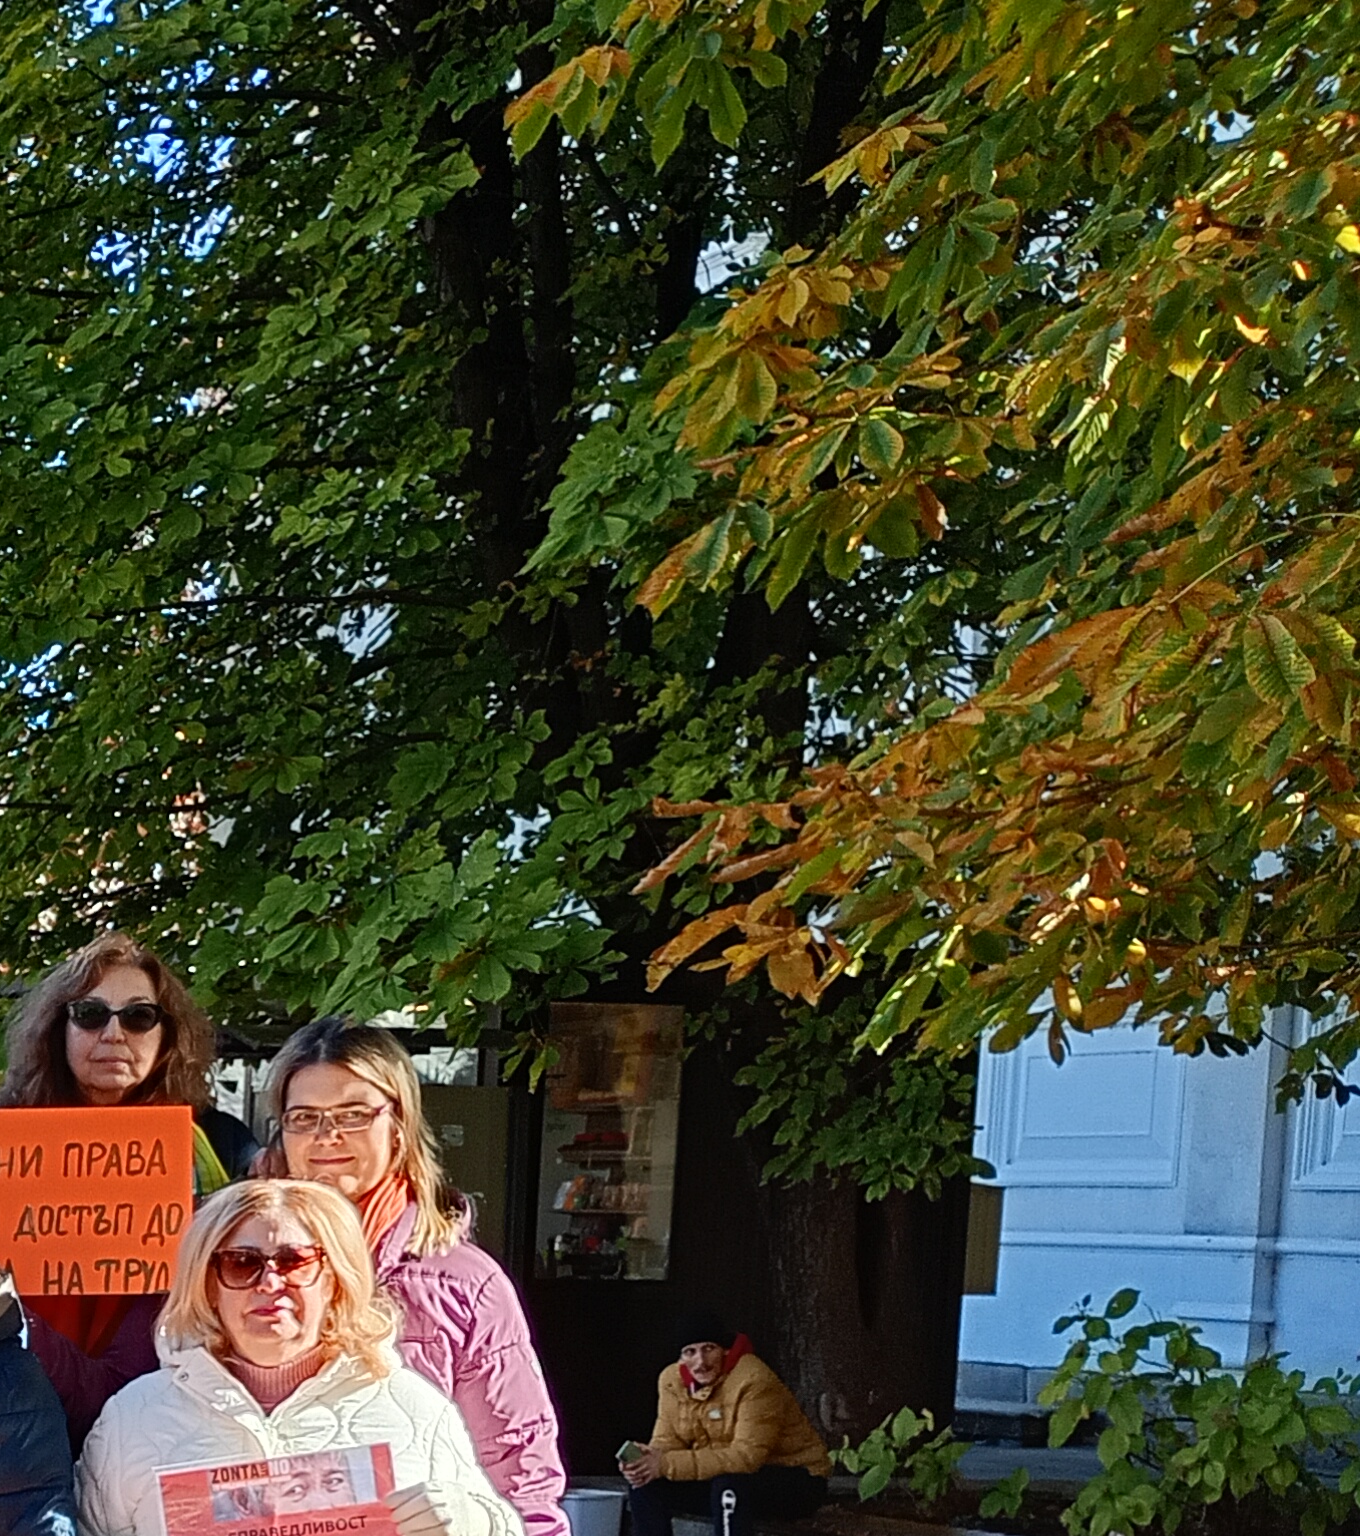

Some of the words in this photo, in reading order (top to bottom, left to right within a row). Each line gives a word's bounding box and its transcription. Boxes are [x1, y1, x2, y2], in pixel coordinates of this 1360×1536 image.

[63, 1138, 167, 1178] ПРАВА
[13, 1202, 133, 1243] ДОСТЪП
[141, 1202, 184, 1247] ДО
[43, 1259, 84, 1295] НА
[210, 1464, 260, 1484] ZONTA
